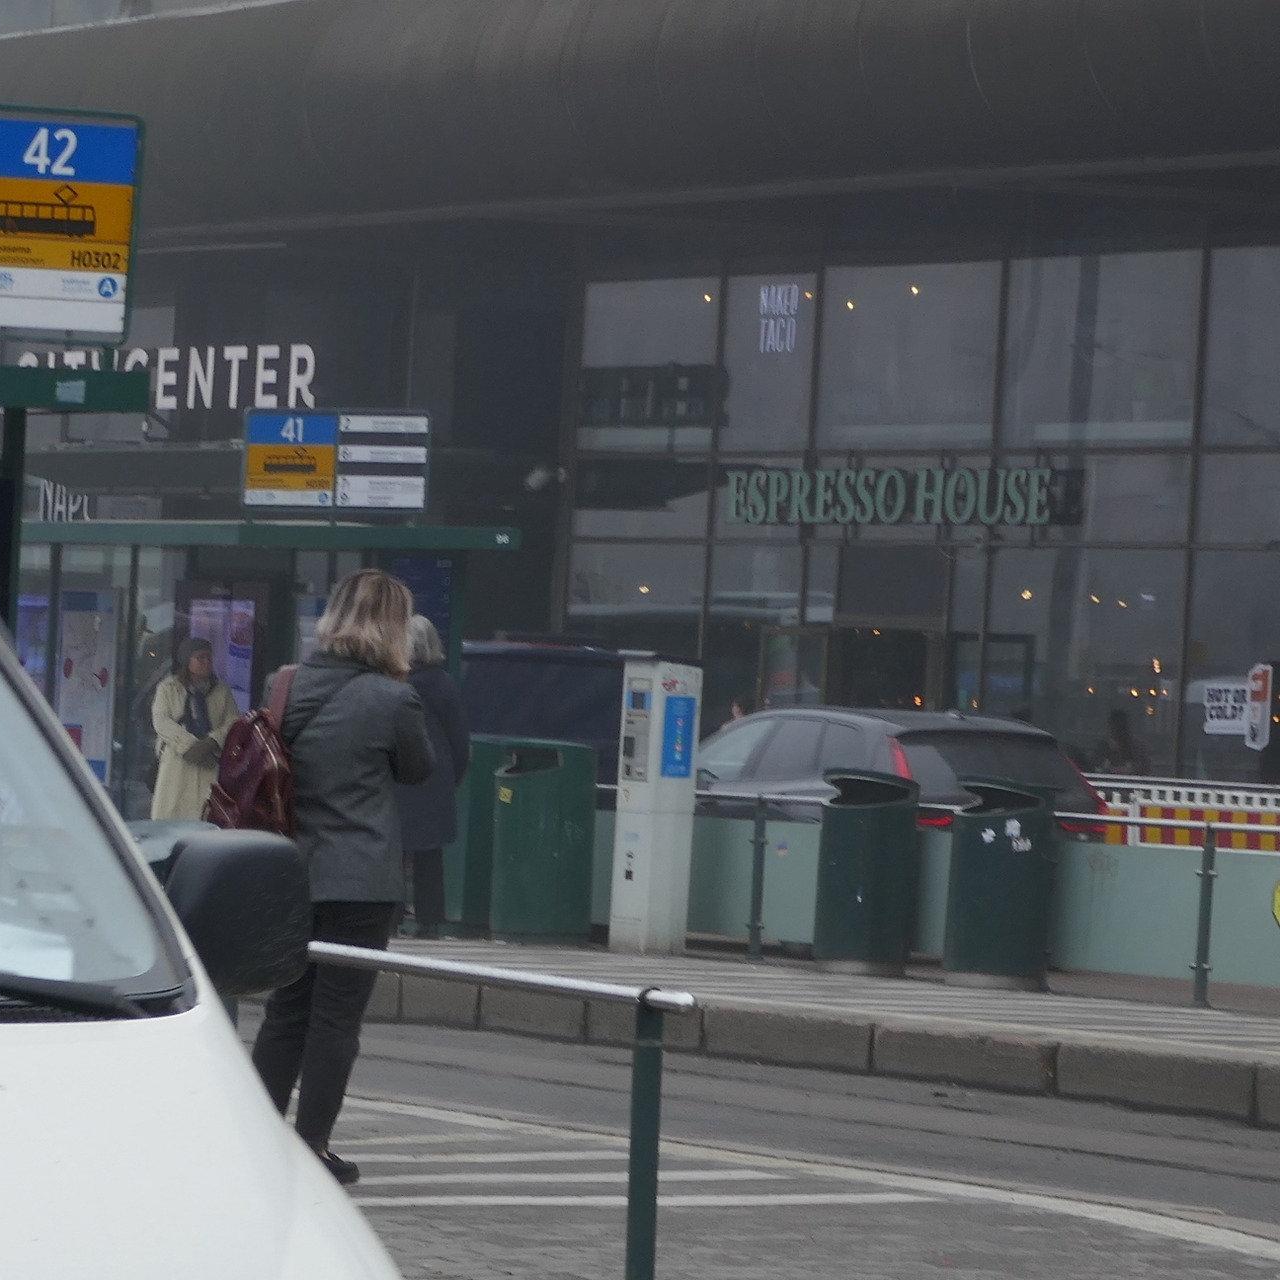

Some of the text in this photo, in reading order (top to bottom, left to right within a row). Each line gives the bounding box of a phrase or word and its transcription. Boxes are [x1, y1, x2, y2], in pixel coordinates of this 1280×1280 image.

[23, 127, 78, 176] 42
[70, 249, 122, 270] H0302
[759, 318, 796, 353] TACO
[280, 417, 304, 442] 41
[725, 466, 1052, 526] ESPRESSO HOUSE
